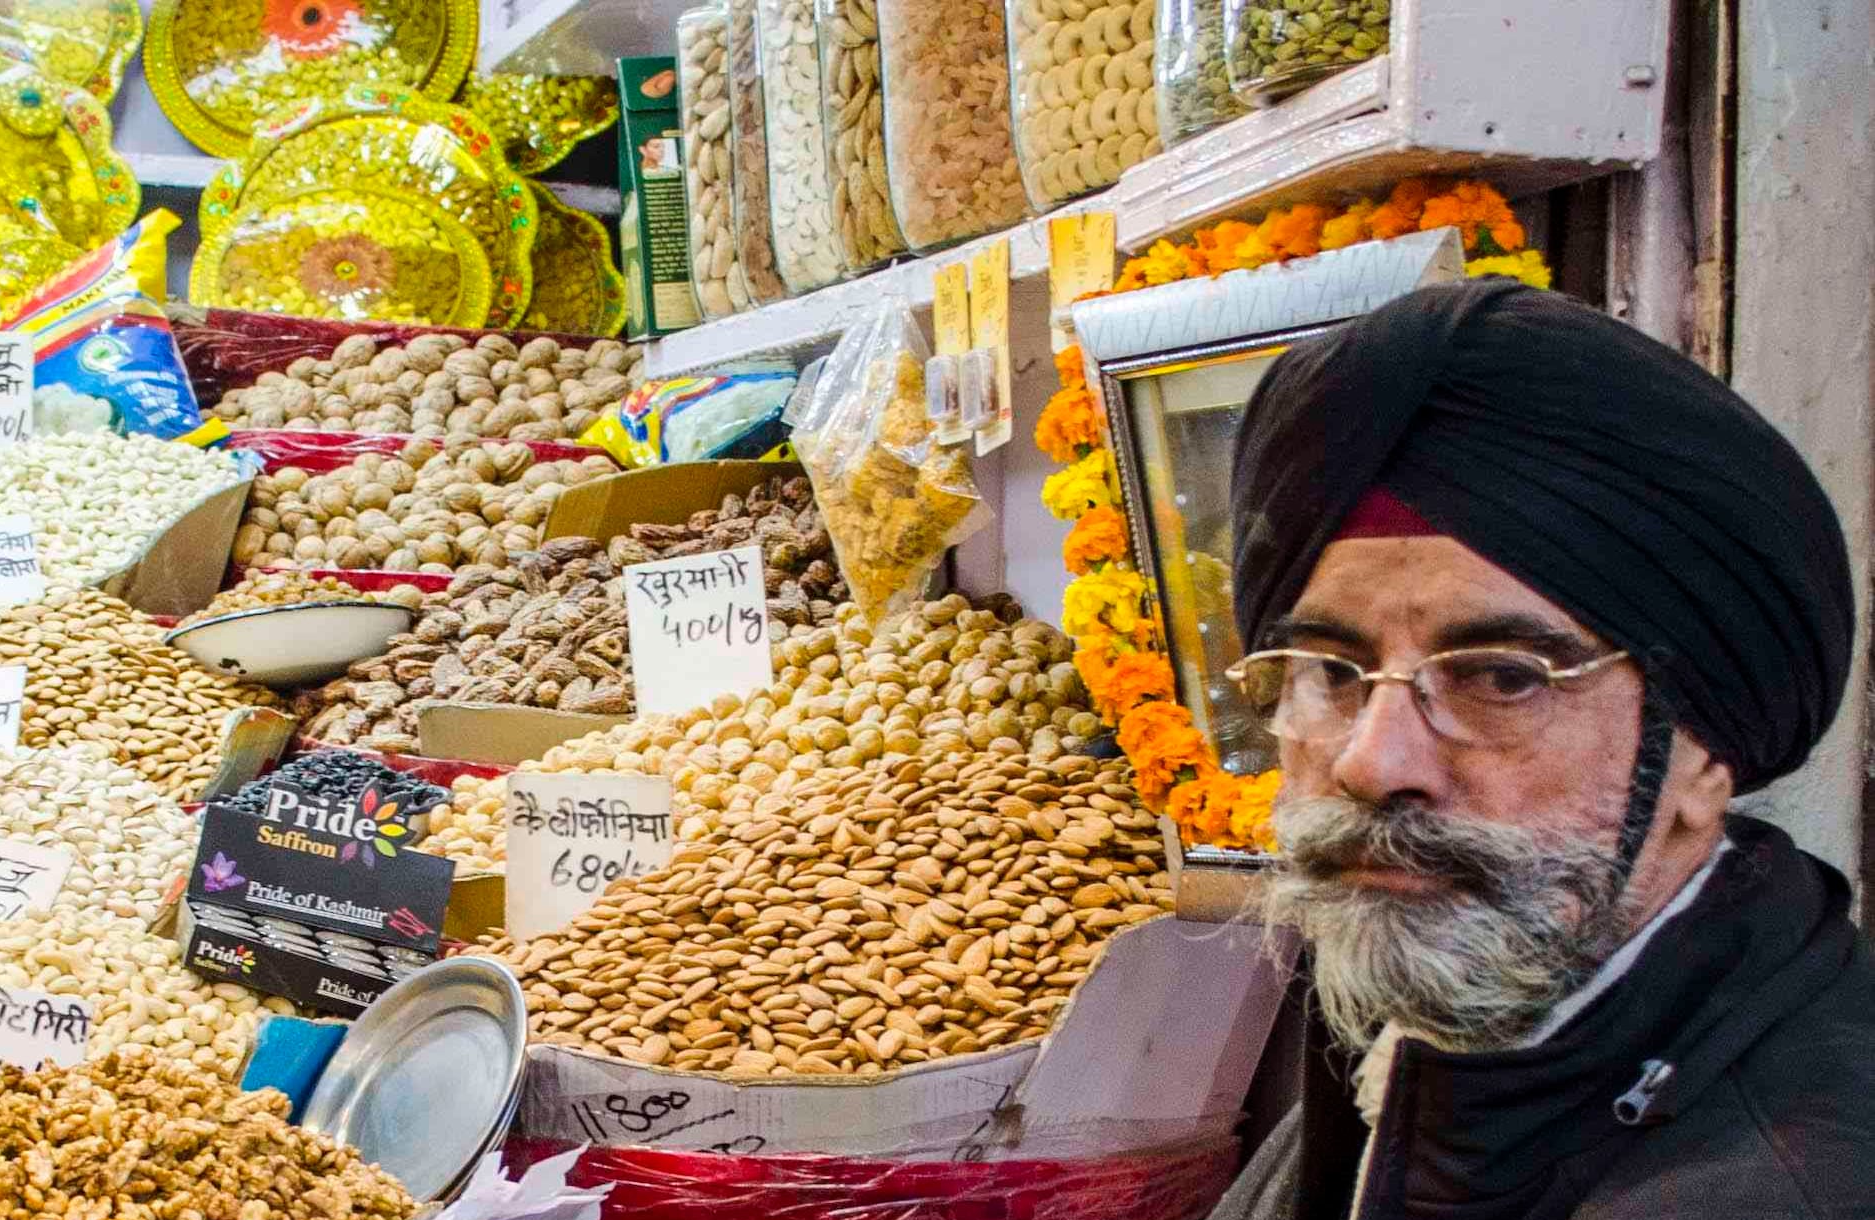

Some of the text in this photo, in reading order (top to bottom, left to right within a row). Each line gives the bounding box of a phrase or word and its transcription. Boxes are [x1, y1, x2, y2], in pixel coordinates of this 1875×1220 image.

[263, 786, 377, 842] Pride
[256, 826, 338, 859] Saffron
[248, 880, 388, 923] Pride of Kashmir
[197, 940, 242, 966] Pride
[318, 977, 374, 1003] Pride of
